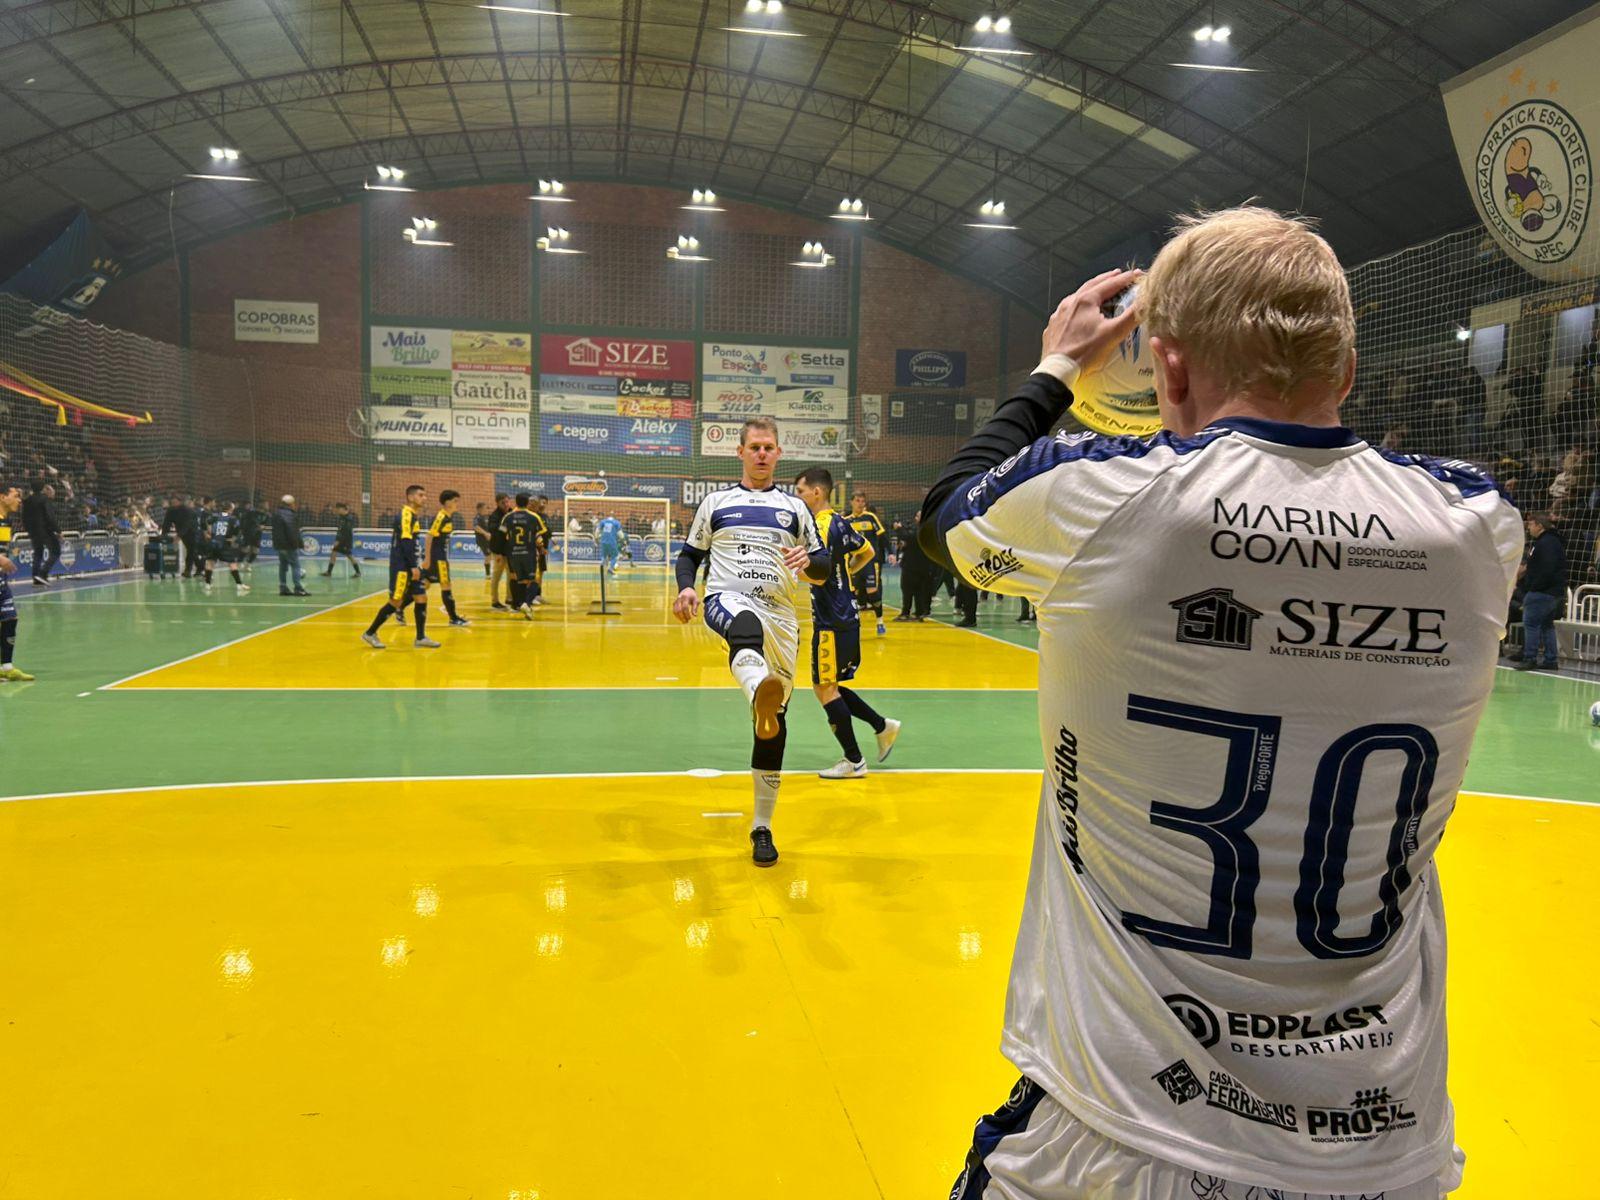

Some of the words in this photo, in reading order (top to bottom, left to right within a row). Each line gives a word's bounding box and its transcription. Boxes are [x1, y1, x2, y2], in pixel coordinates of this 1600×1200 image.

[1487, 107, 1536, 153] PRATICK
[1539, 108, 1586, 169] ESPORTE
[1566, 173, 1587, 233] CLUBE
[1534, 241, 1565, 261] APEC
[237, 310, 316, 326] COPOBRAS
[383, 331, 426, 347] Mais
[391, 348, 440, 362] Brilho
[605, 342, 669, 365] SIZE
[712, 345, 742, 357] Ponto
[800, 353, 845, 366] Setta
[453, 379, 528, 401] Gaúcha
[718, 393, 754, 401] MOTO
[720, 403, 761, 413] SILVA
[375, 420, 448, 433] MUNDIAL
[563, 427, 608, 440] cegero
[1213, 497, 1396, 541] MARINA
[515, 525, 525, 545] 2
[91, 544, 115, 561] cegero
[1210, 529, 1342, 571] COAN
[1347, 546, 1428, 560] ODONTOLOGIA
[1347, 557, 1428, 572] ESPECIALIZADA
[1276, 597, 1449, 654] SIZE
[1269, 646, 1341, 660] MATERIAIS
[1345, 652, 1362, 661] DE
[1366, 653, 1451, 668] CONSTRUÇÃO
[1121, 693, 1440, 961] 30
[1226, 1004, 1388, 1040] EDPLAST
[1230, 1031, 1394, 1058] DESCARTÁVEIS
[1209, 1070, 1233, 1087] CASA
[1207, 1081, 1297, 1127] FERRAGENS
[1306, 1103, 1416, 1136] PROSIL
